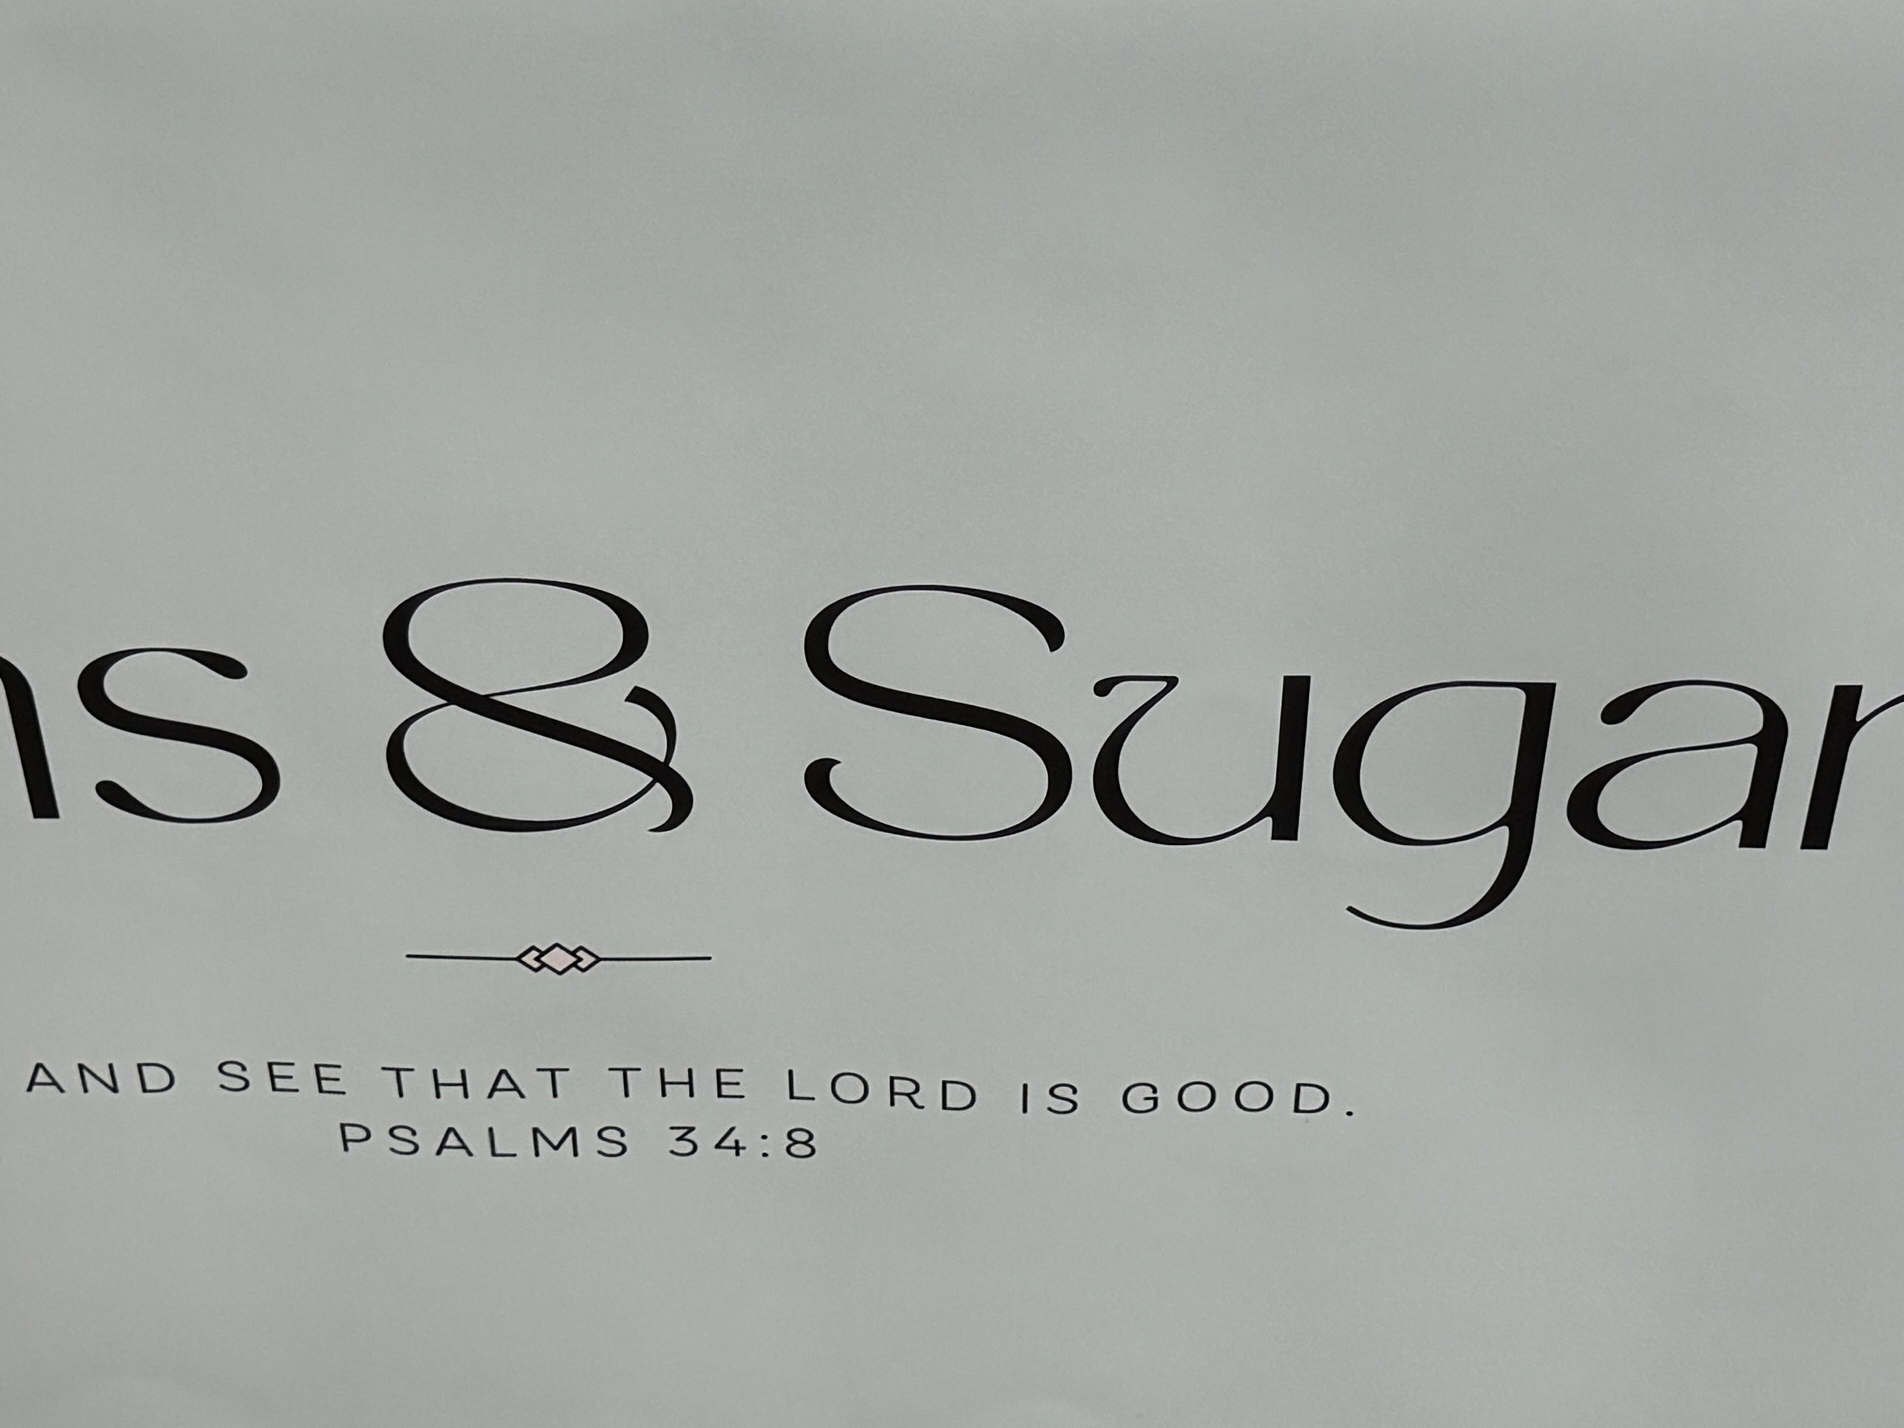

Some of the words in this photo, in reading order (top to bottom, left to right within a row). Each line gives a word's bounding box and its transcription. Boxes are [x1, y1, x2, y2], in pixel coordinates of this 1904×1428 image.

[382, 578, 693, 833] &
[25, 1061, 176, 1095] AND
[217, 1059, 347, 1096] SEE
[380, 1066, 571, 1100] THAT
[607, 1067, 746, 1100] THE
[787, 1068, 977, 1112] LORD
[1021, 1082, 1079, 1115] IS
[1121, 1080, 1357, 1115] GOOD.
[339, 1122, 628, 1158] PSALMS
[668, 1125, 817, 1160] 34:8
